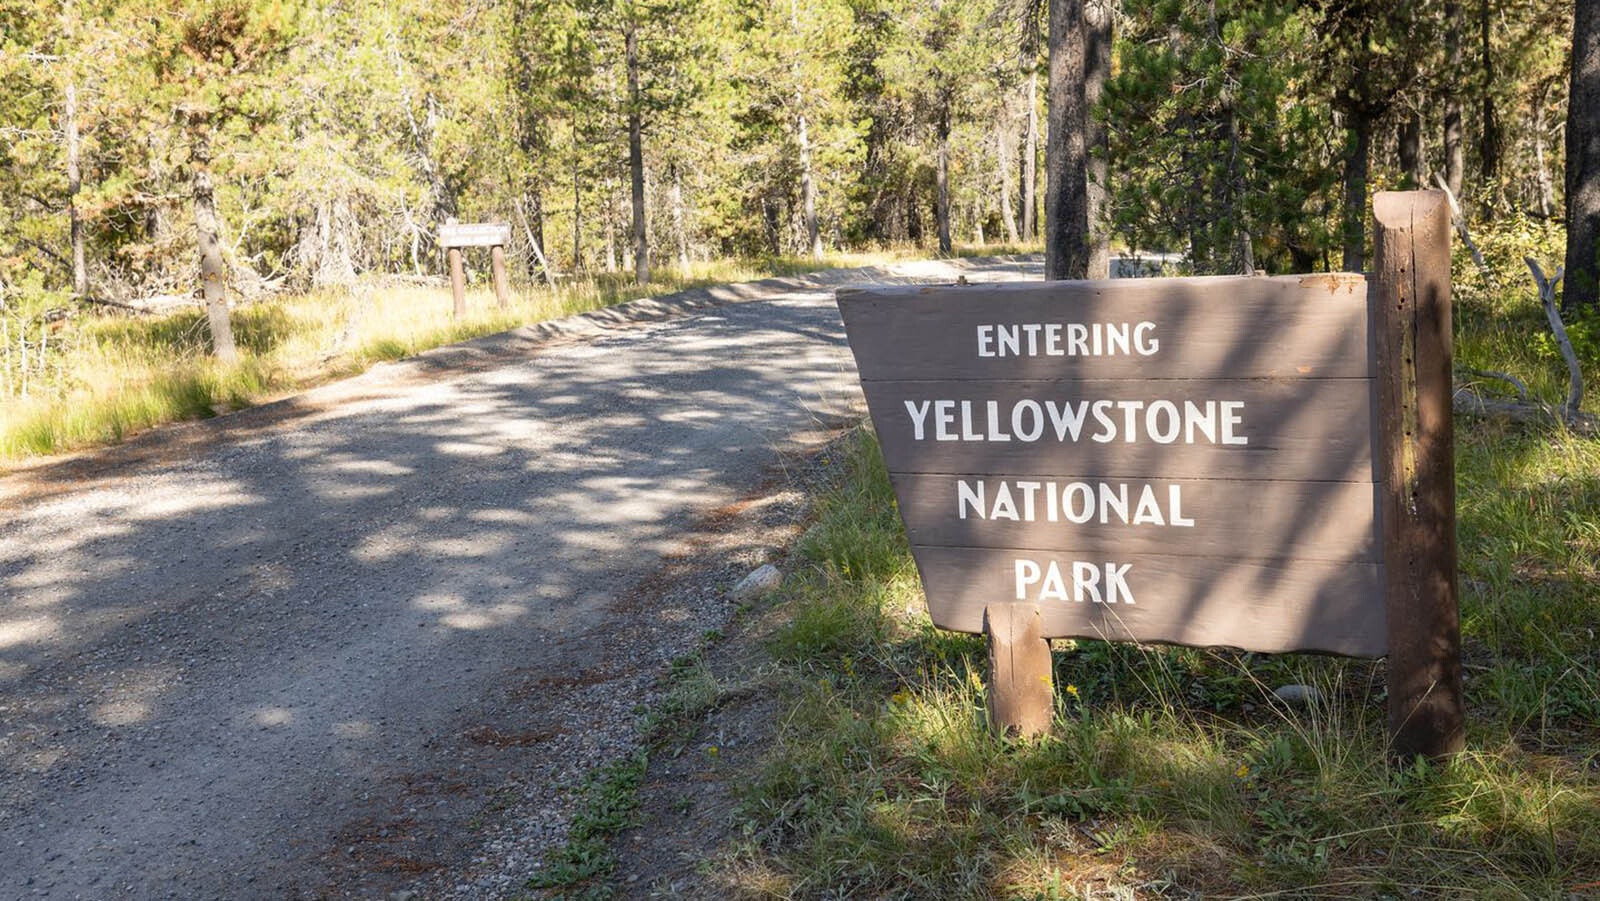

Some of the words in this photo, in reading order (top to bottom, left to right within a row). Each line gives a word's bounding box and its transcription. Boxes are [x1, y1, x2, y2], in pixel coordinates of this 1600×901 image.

[977, 320, 1160, 358] ENTERING
[904, 399, 1249, 446] YELLOWSTONE
[957, 480, 1195, 528] NATIONAL
[1015, 558, 1137, 605] PARK
